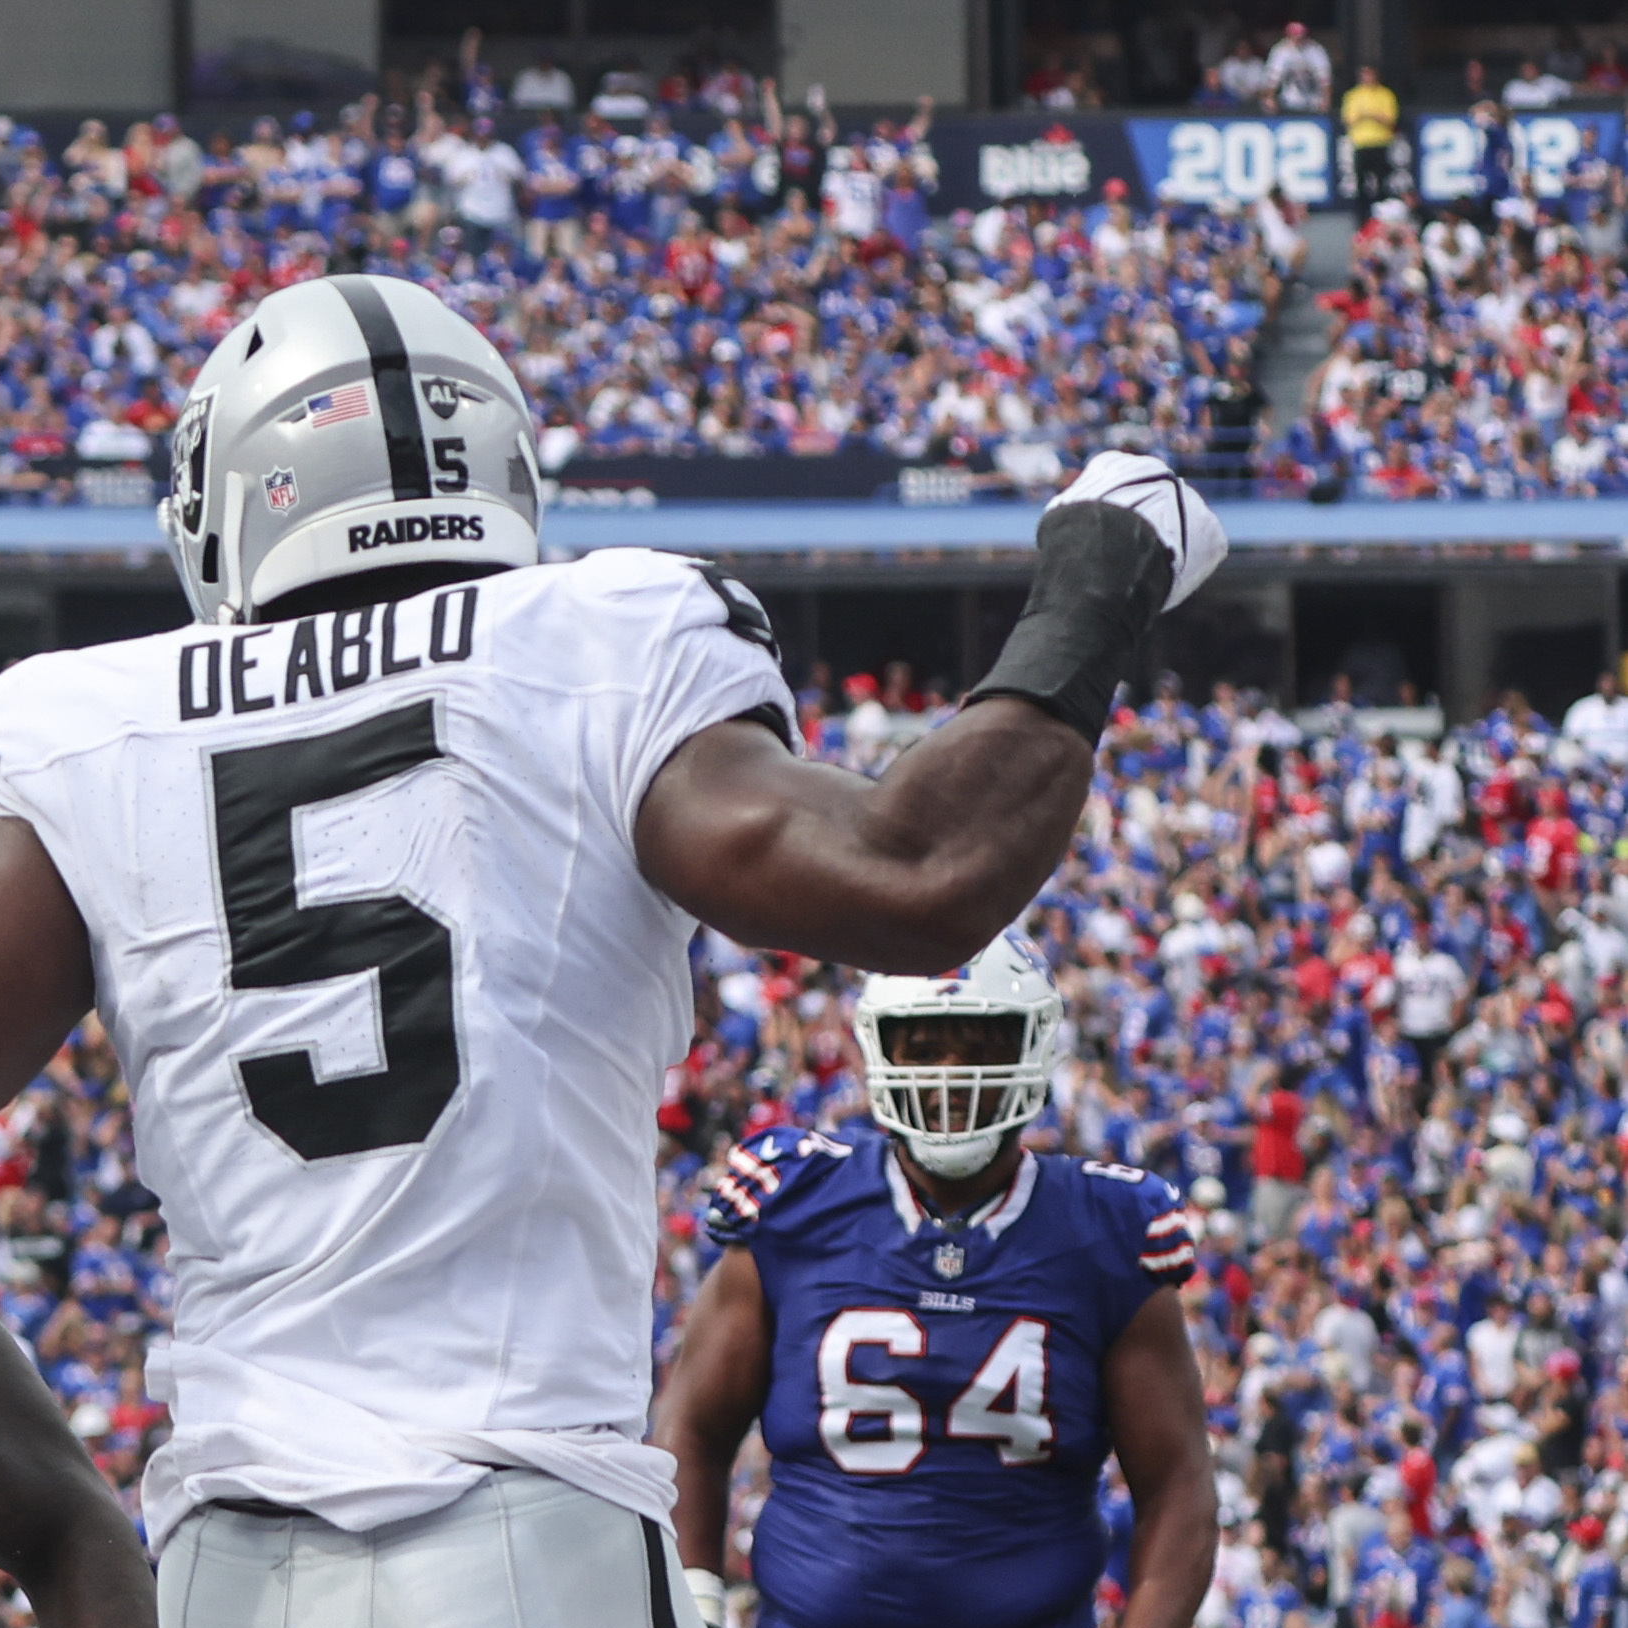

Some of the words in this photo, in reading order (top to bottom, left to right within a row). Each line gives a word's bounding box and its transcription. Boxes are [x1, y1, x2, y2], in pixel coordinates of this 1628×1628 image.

[1167, 121, 1327, 200] 202
[428, 385, 456, 404] AL
[432, 437, 469, 492] 5
[269, 485, 296, 507] NFL
[348, 514, 485, 553] RAIDERS
[179, 586, 479, 721] DEABLO
[200, 698, 471, 1170] 5
[918, 1290, 977, 1313] BILLS
[816, 1306, 1057, 1475] 64
